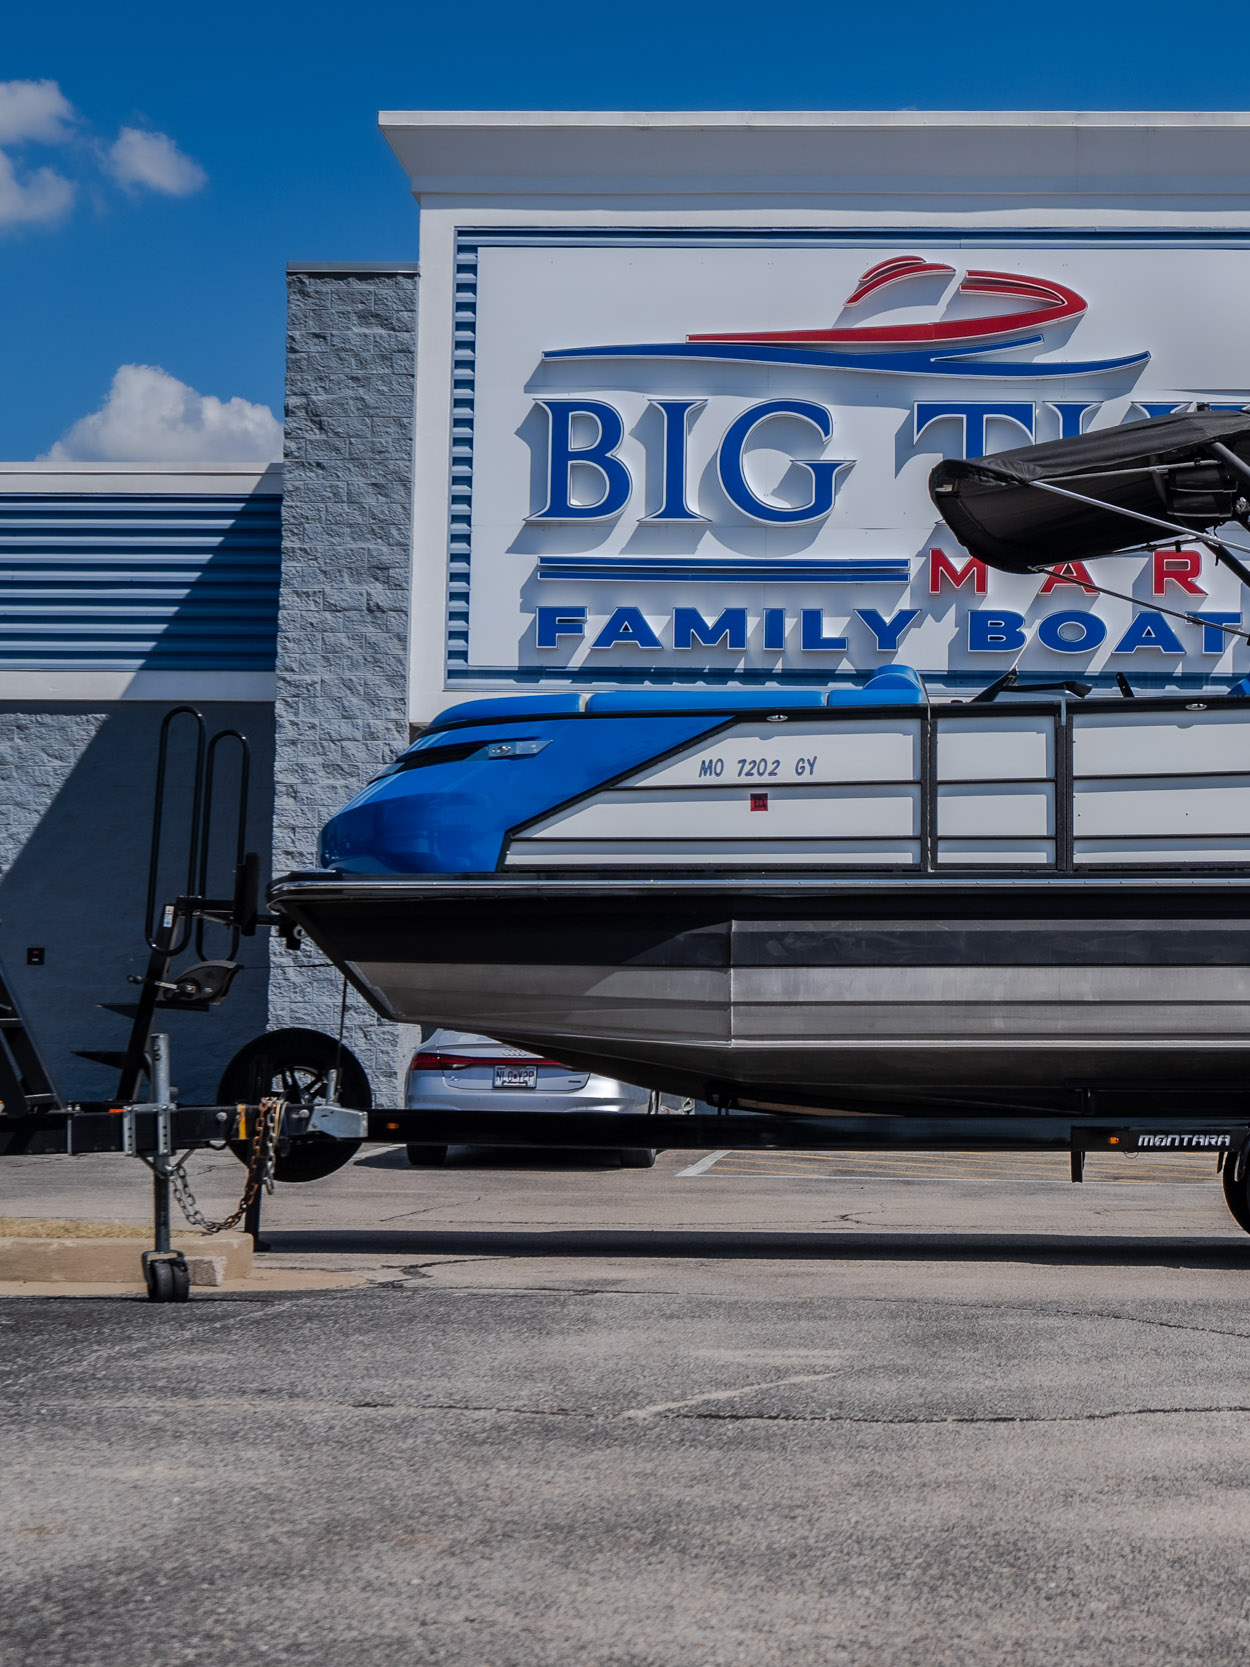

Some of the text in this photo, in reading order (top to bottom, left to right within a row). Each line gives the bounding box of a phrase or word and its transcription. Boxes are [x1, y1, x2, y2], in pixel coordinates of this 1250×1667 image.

[522, 397, 856, 523] BIG
[535, 606, 921, 651] FAMILY
[699, 756, 817, 778] MO 7202 GY
[1138, 1134, 1231, 1146] MONTARA
